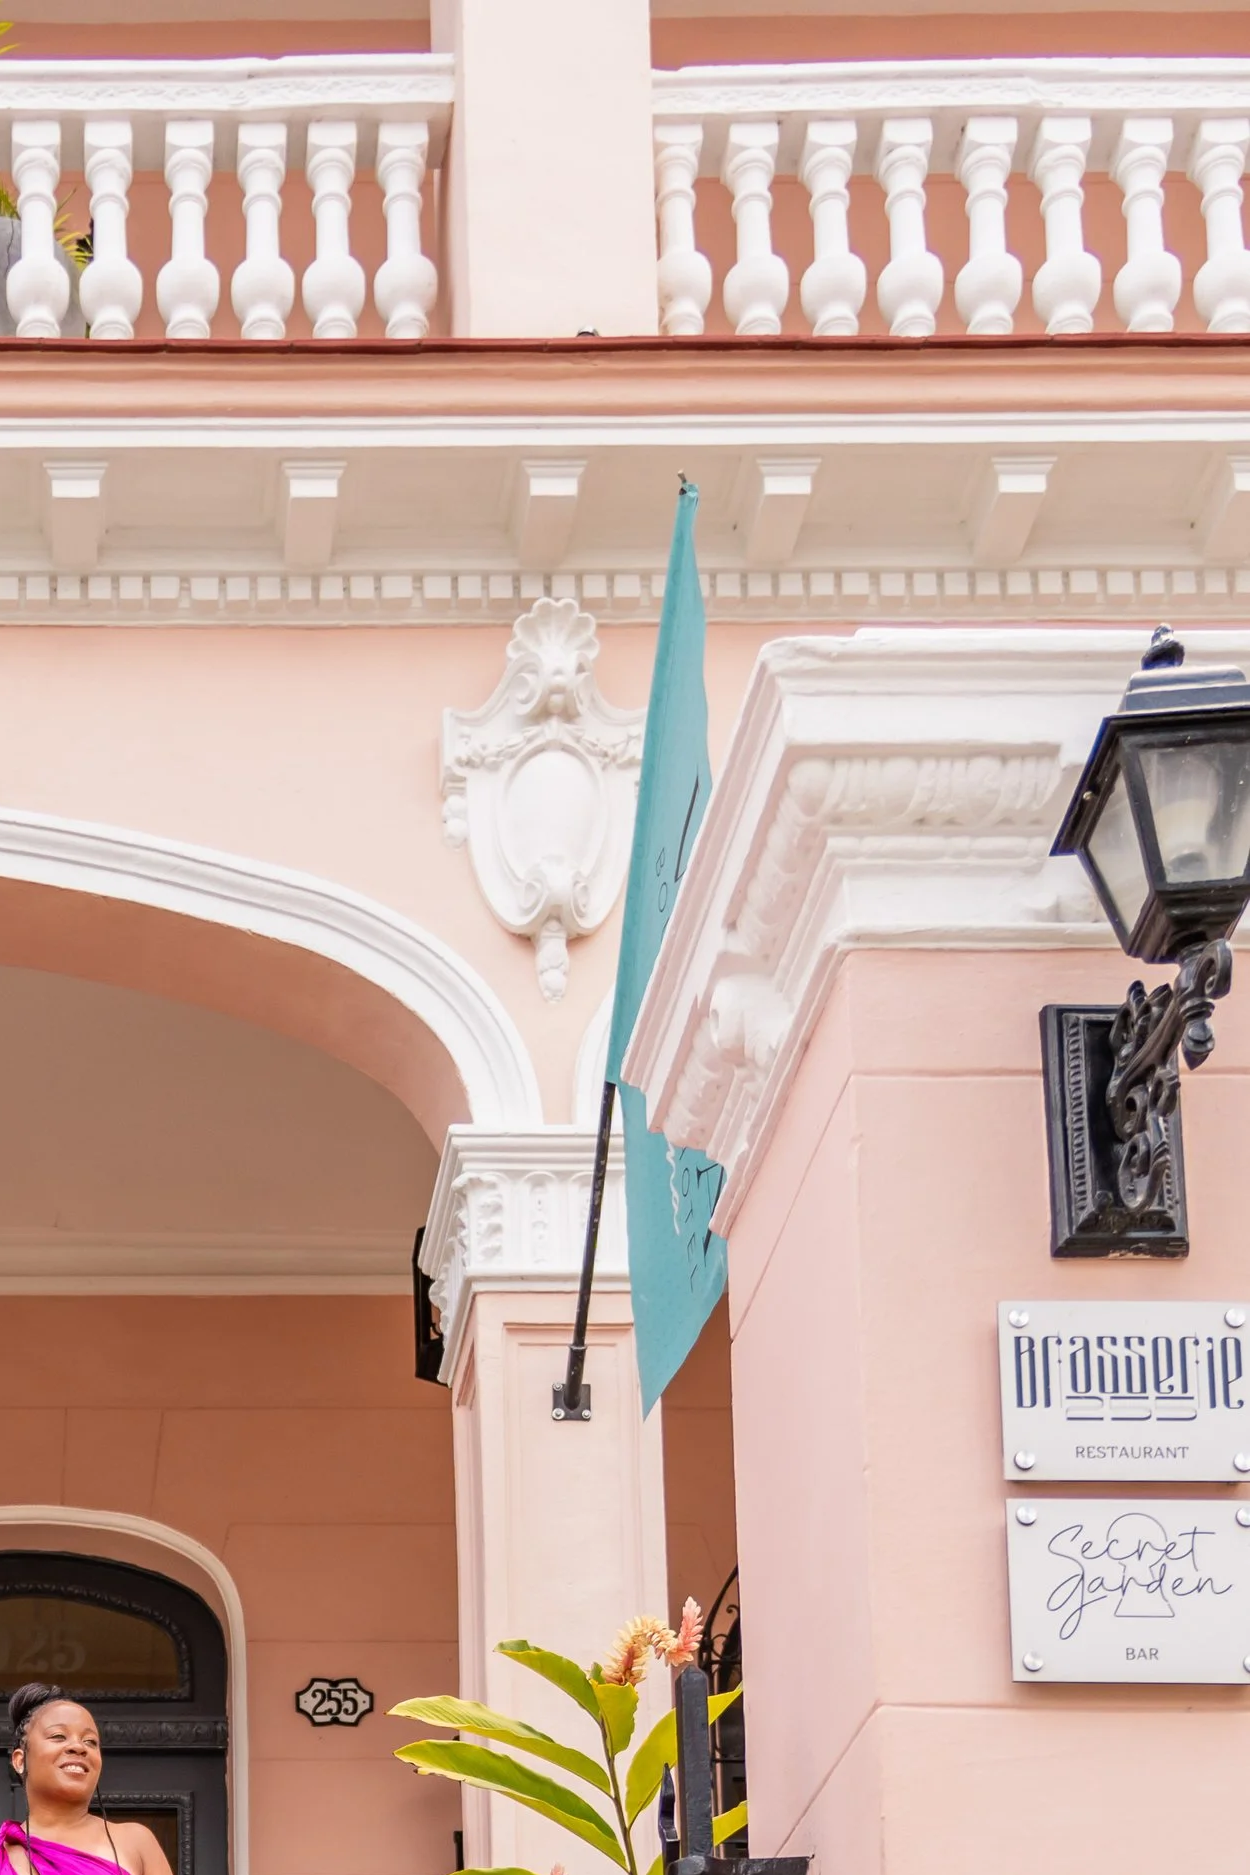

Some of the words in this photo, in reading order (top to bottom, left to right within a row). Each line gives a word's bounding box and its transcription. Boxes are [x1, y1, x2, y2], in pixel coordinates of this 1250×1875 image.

[1013, 1334, 1245, 1410] Brasserie
[1075, 1446, 1190, 1460] RESTAURANT
[1048, 1525, 1216, 1573] Secret
[1125, 1648, 1160, 1661] BAR
[311, 1688, 358, 1716] 255
